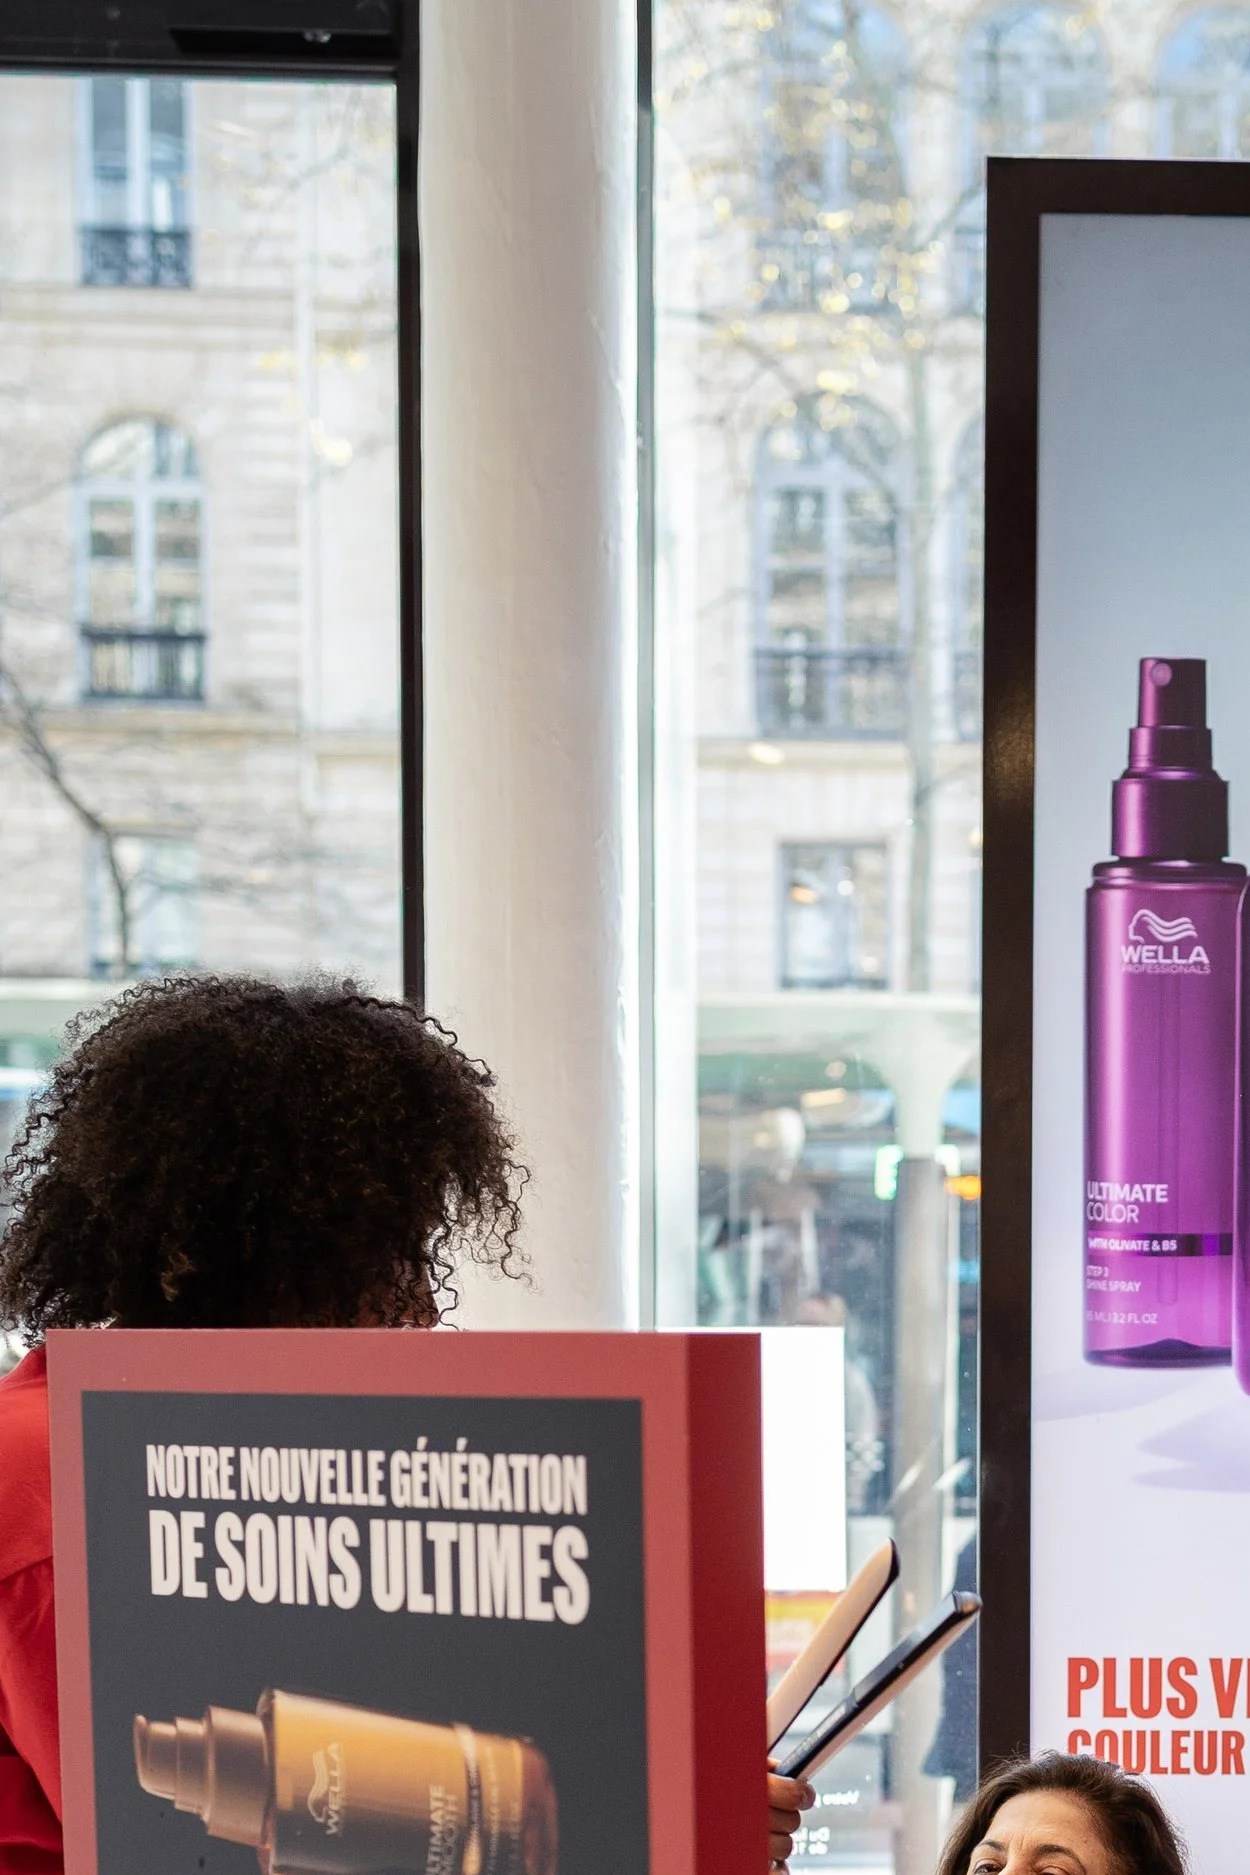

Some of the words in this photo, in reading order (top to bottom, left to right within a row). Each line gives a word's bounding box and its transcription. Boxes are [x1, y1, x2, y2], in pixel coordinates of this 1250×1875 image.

[1121, 944, 1210, 964] WELLA
[1121, 963, 1211, 974] PROFESSIONALS
[1087, 1181, 1169, 1203] ULTIMATE
[1086, 1202, 1139, 1223] COLOR
[1151, 1240, 1161, 1251] &
[1162, 1240, 1177, 1251] B5
[1108, 1280, 1141, 1292] SPRAY
[1128, 1313, 1140, 1323] FL
[1142, 1313, 1157, 1324] OZ
[146, 1444, 234, 1500] NOTRE
[240, 1446, 386, 1507] NOUVELLE
[390, 1436, 588, 1516] GÉNÉRATION
[148, 1510, 209, 1599] DE
[214, 1513, 362, 1610] SOINS
[370, 1518, 590, 1624] ULTIMES
[1067, 1657, 1198, 1720] PLUS
[1068, 1729, 1245, 1776] COULEUR
[326, 1742, 341, 1834] WELLA
